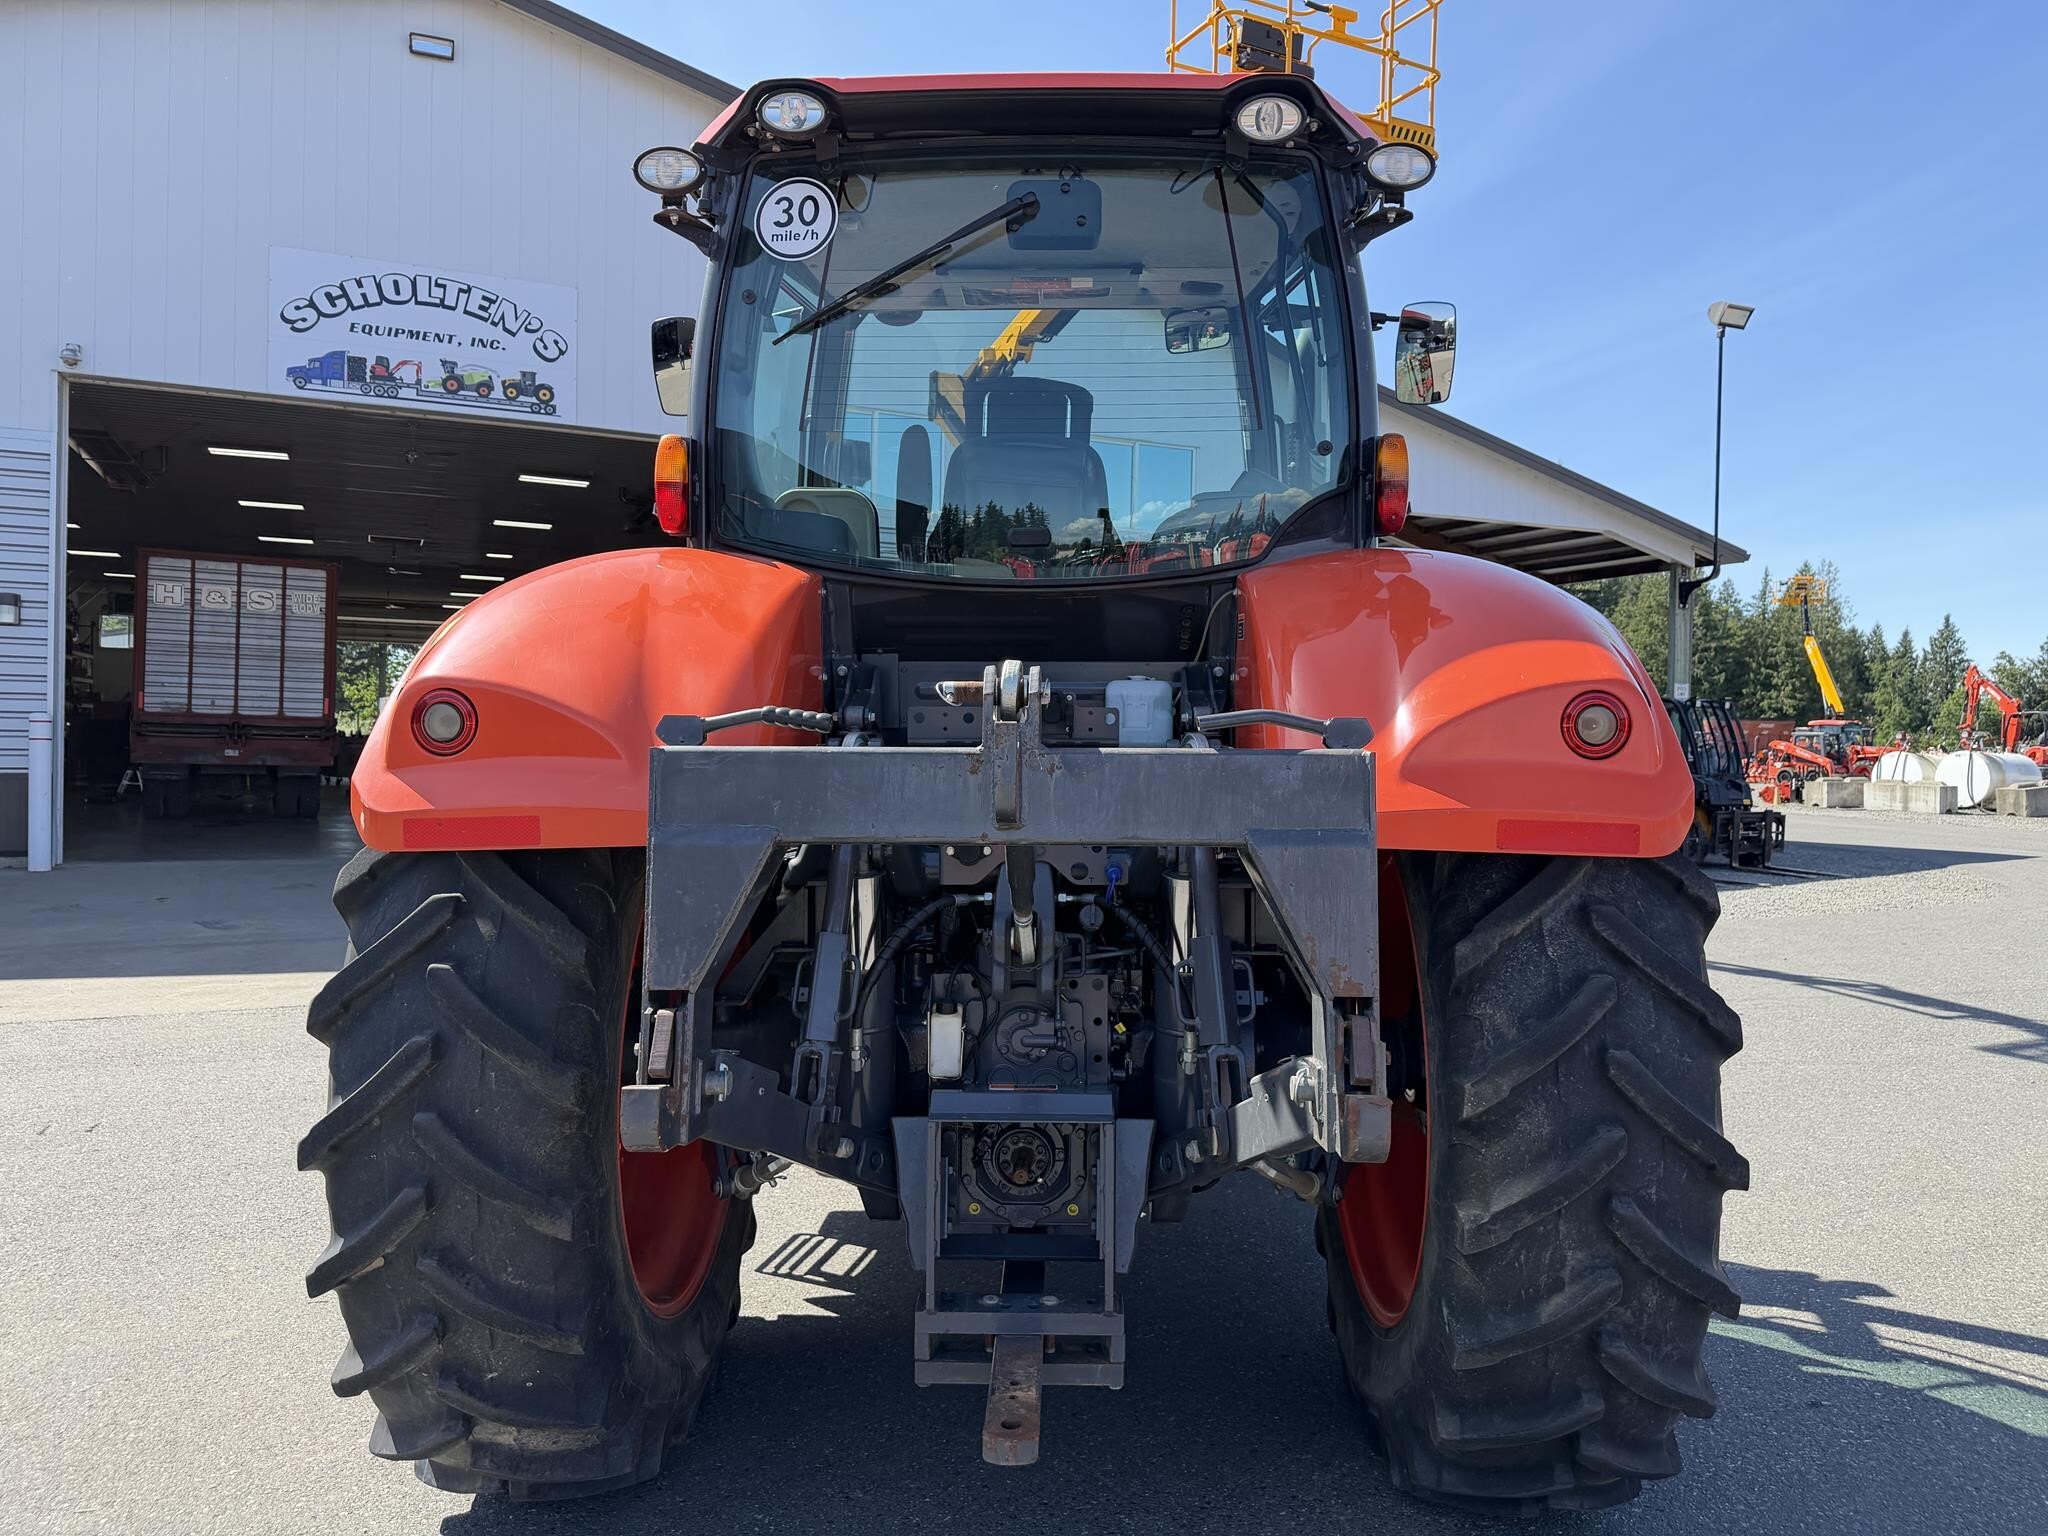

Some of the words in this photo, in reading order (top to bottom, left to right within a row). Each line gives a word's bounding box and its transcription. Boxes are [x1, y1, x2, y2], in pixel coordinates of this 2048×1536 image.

[773, 195, 820, 228] 30
[771, 229, 819, 242] mile/h
[280, 273, 568, 362] SCHOLTEN'S
[349, 322, 462, 347] EQUIPMENT,
[470, 337, 507, 351] INC.
[155, 583, 184, 606] H
[249, 590, 275, 610] S
[292, 592, 320, 603] WIDE
